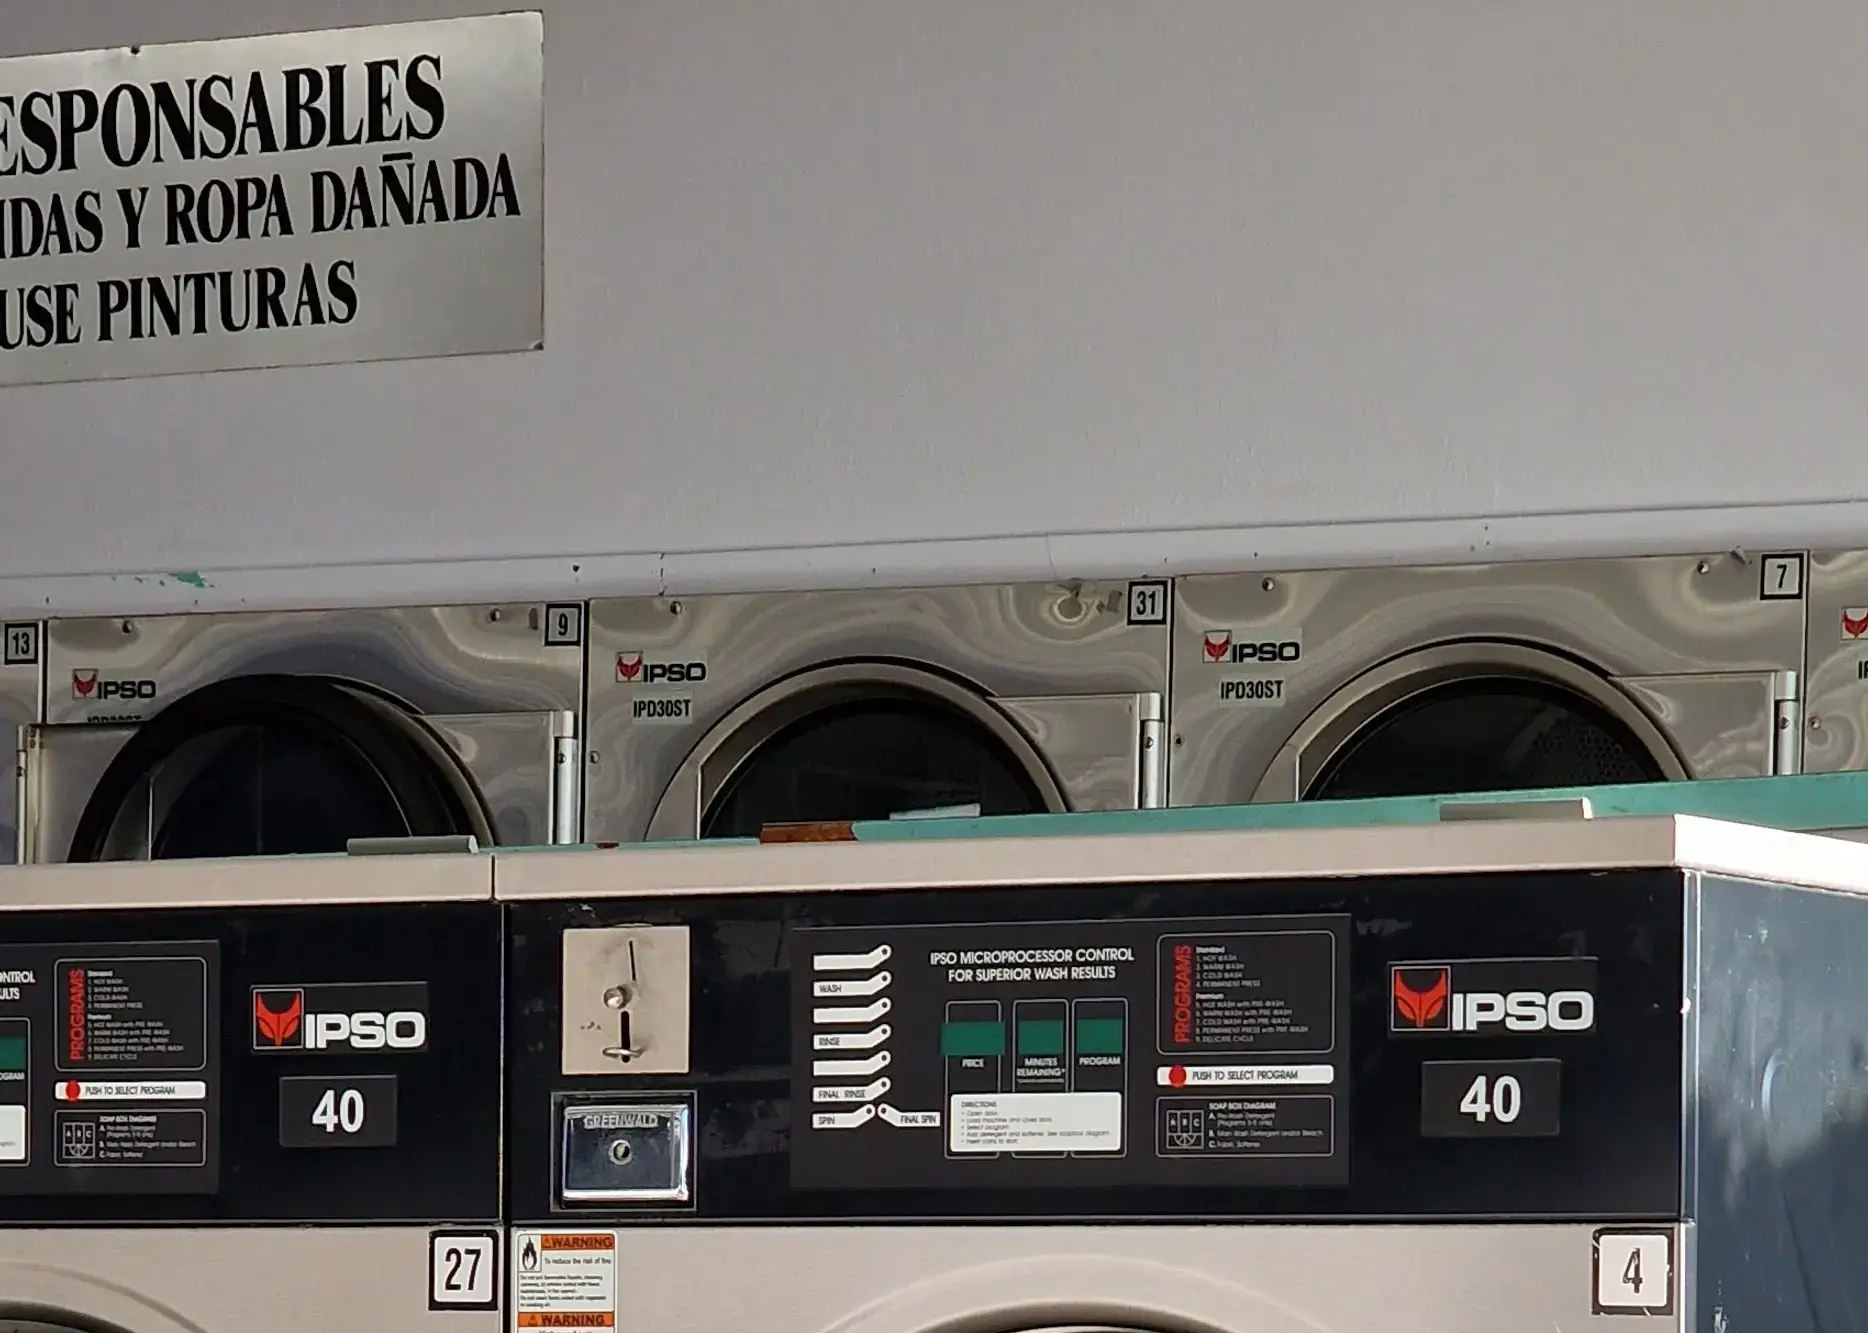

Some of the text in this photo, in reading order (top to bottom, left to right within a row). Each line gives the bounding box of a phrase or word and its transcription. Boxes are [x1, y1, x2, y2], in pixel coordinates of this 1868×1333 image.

[116, 186, 150, 249] Y
[165, 173, 295, 246] ROPA
[311, 152, 522, 233] DAÑADA
[0, 260, 359, 350] USE PINTURAS
[1775, 564, 1788, 589] 7
[1136, 590, 1157, 615] 31
[558, 613, 568, 636] 9
[12, 632, 30, 655] 13
[1232, 641, 1300, 663] IPSO
[642, 662, 707, 683] IPSO
[97, 680, 156, 699] IPSO
[1220, 680, 1284, 700] IPD30ST
[633, 699, 692, 718] IPD30ST
[930, 948, 1135, 965] IPSO MICROPROCESSOR CONTROL
[949, 966, 1116, 982] FOR SUPERIOR WASH RESULTS
[819, 984, 842, 993] WASH
[1174, 945, 1192, 1042] PROGRAMS
[70, 969, 85, 1061] PROGRAMS
[1451, 991, 1594, 1031] IPSO
[305, 1011, 427, 1049] IPSO
[819, 1037, 840, 1046] RINSE
[962, 1059, 985, 1068] PRICE
[1025, 1058, 1058, 1066] MINUTES
[1079, 1057, 1121, 1066] PROGRAM
[1192, 1070, 1298, 1080] PUSH TO SELECT PROGRAM
[85, 1086, 102, 1095] PUSH
[104, 1086, 113, 1095] TO
[140, 1086, 175, 1095] PROGRAM
[819, 1089, 866, 1098] FINAL RINSE
[1460, 1075, 1521, 1123] 40
[312, 1089, 364, 1133] 40
[818, 1116, 836, 1125] SPIN
[901, 1115, 936, 1124] FINAL SPIN
[583, 1114, 658, 1129] GREENWALD
[552, 1237, 613, 1248] WARNING
[444, 1248, 481, 1291] 27
[1622, 1247, 1643, 1293] 4
[541, 1315, 605, 1326] WARNING
